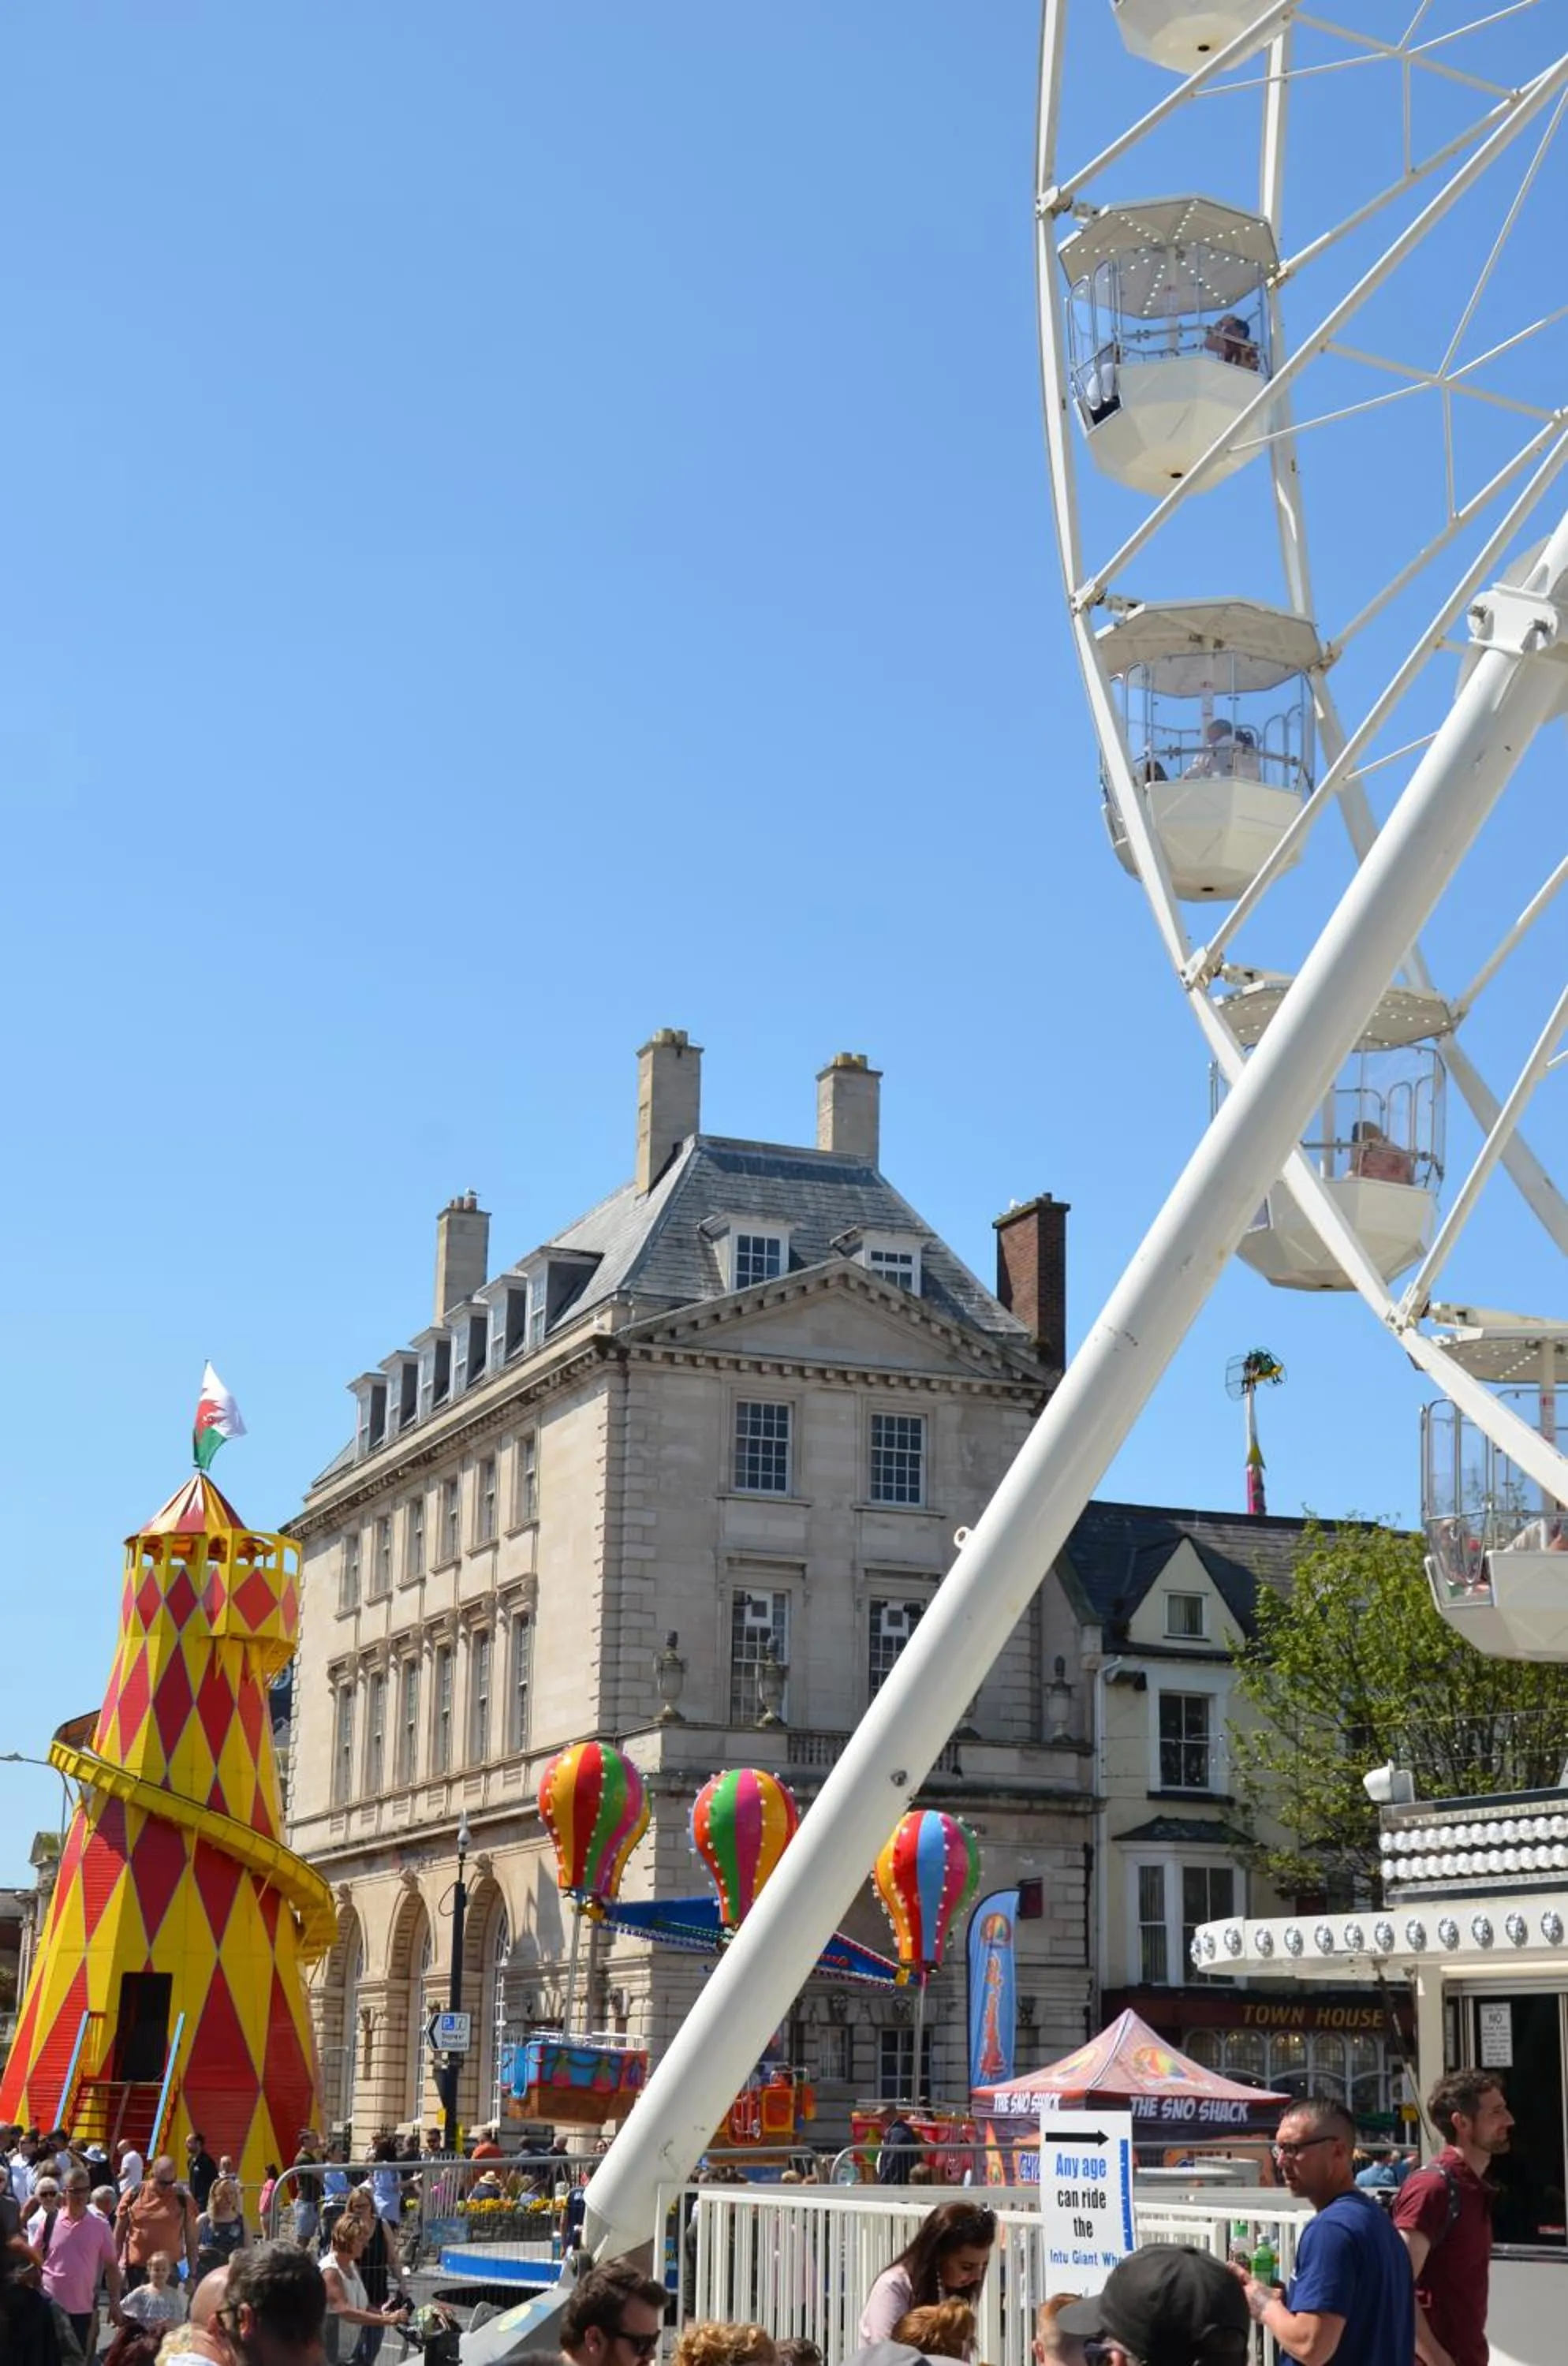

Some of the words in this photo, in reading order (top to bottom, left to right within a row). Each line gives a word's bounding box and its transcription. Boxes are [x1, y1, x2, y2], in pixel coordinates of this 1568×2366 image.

[1242, 2005, 1305, 2025] TOWN
[1316, 2007, 1384, 2028] HOUSE
[994, 2092, 1010, 2113] THE
[1010, 2090, 1030, 2114] SNO
[1129, 2095, 1159, 2118] THE
[1161, 2097, 1195, 2120] SNO
[1199, 2100, 1250, 2123] SHACK
[1055, 2153, 1080, 2179] Any
[1082, 2158, 1107, 2180] age
[1058, 2189, 1079, 2208] can
[1081, 2187, 1107, 2209] ride
[1073, 2215, 1093, 2238] the
[1072, 2249, 1099, 2267] Giant
